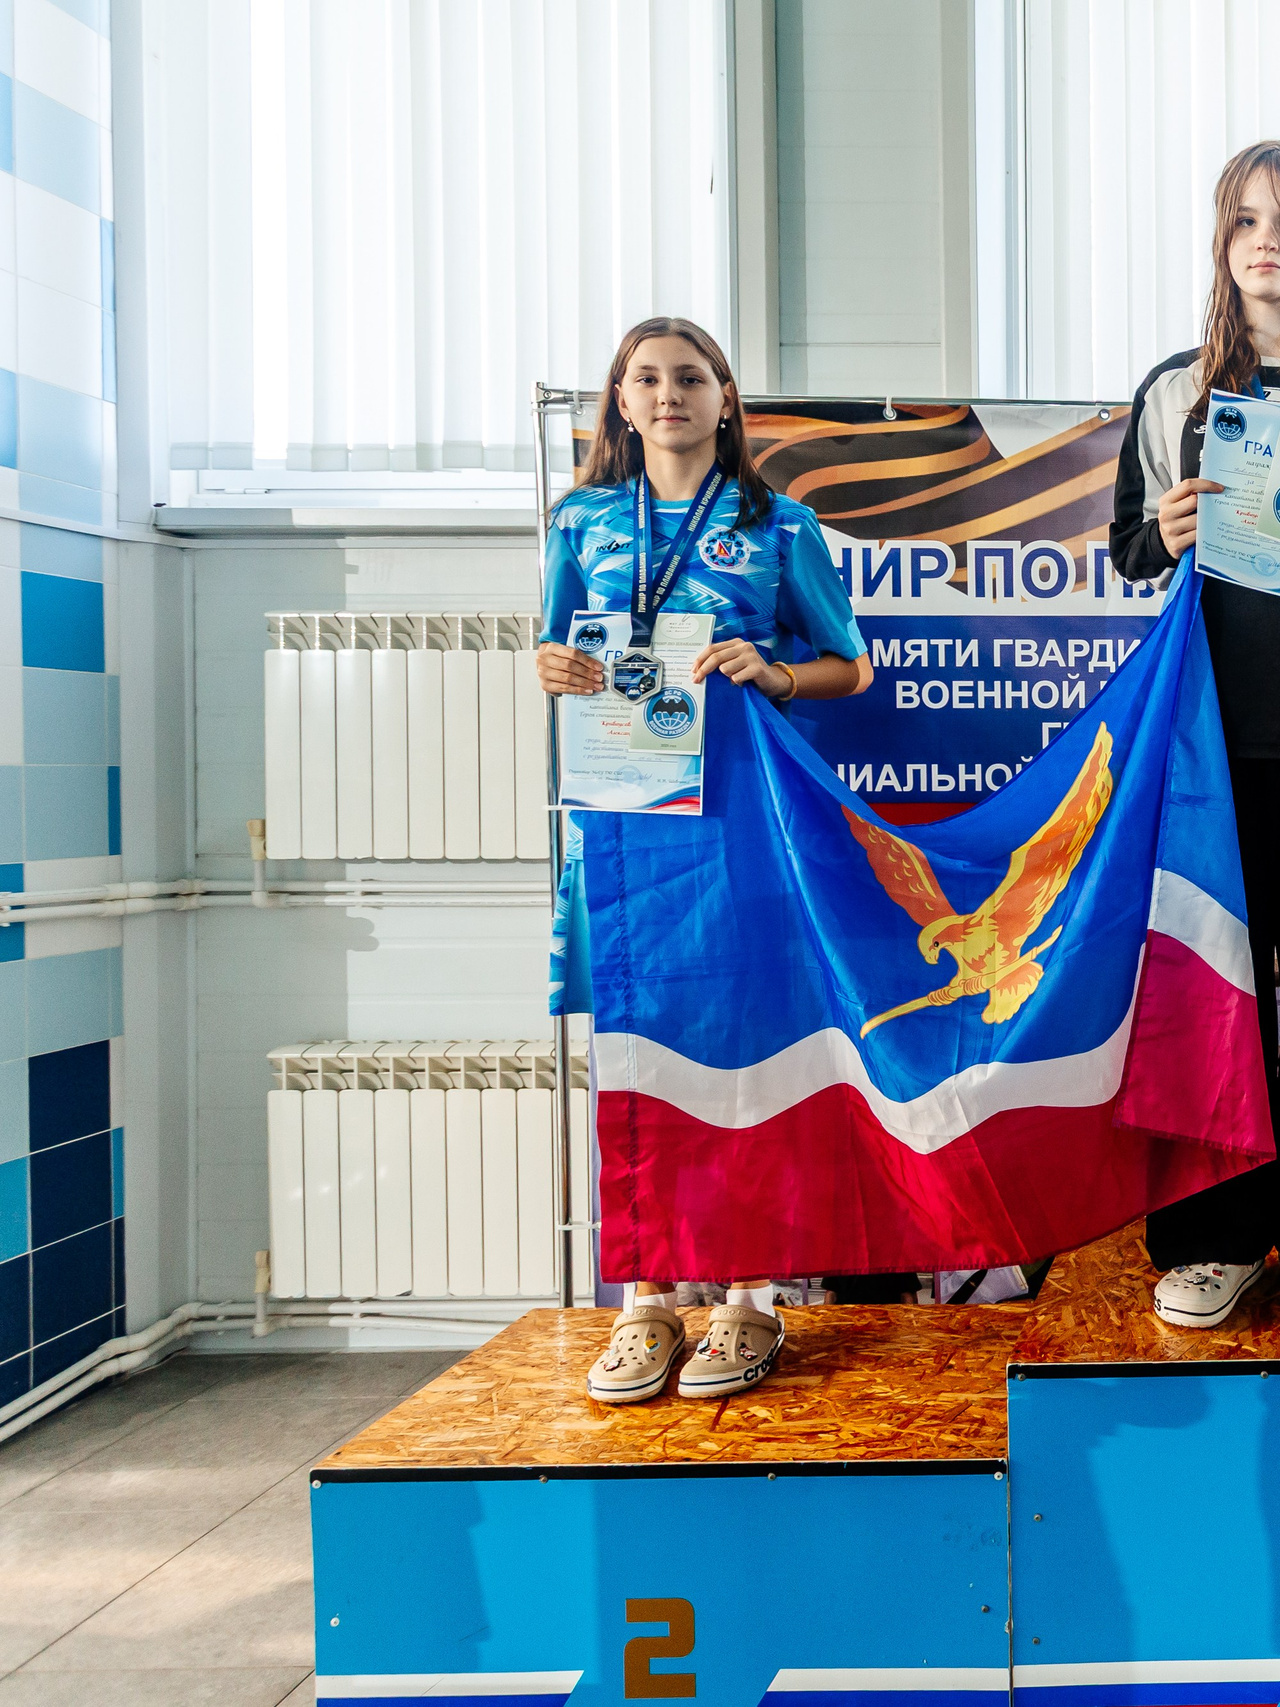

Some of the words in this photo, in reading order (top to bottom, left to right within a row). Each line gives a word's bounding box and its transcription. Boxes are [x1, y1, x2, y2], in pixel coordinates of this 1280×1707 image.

[974, 546, 1068, 599] ПО
[872, 639, 978, 668] МЯТИ
[896, 673, 1086, 709] ВОЕННОЙ
[624, 1597, 696, 1699] 2
